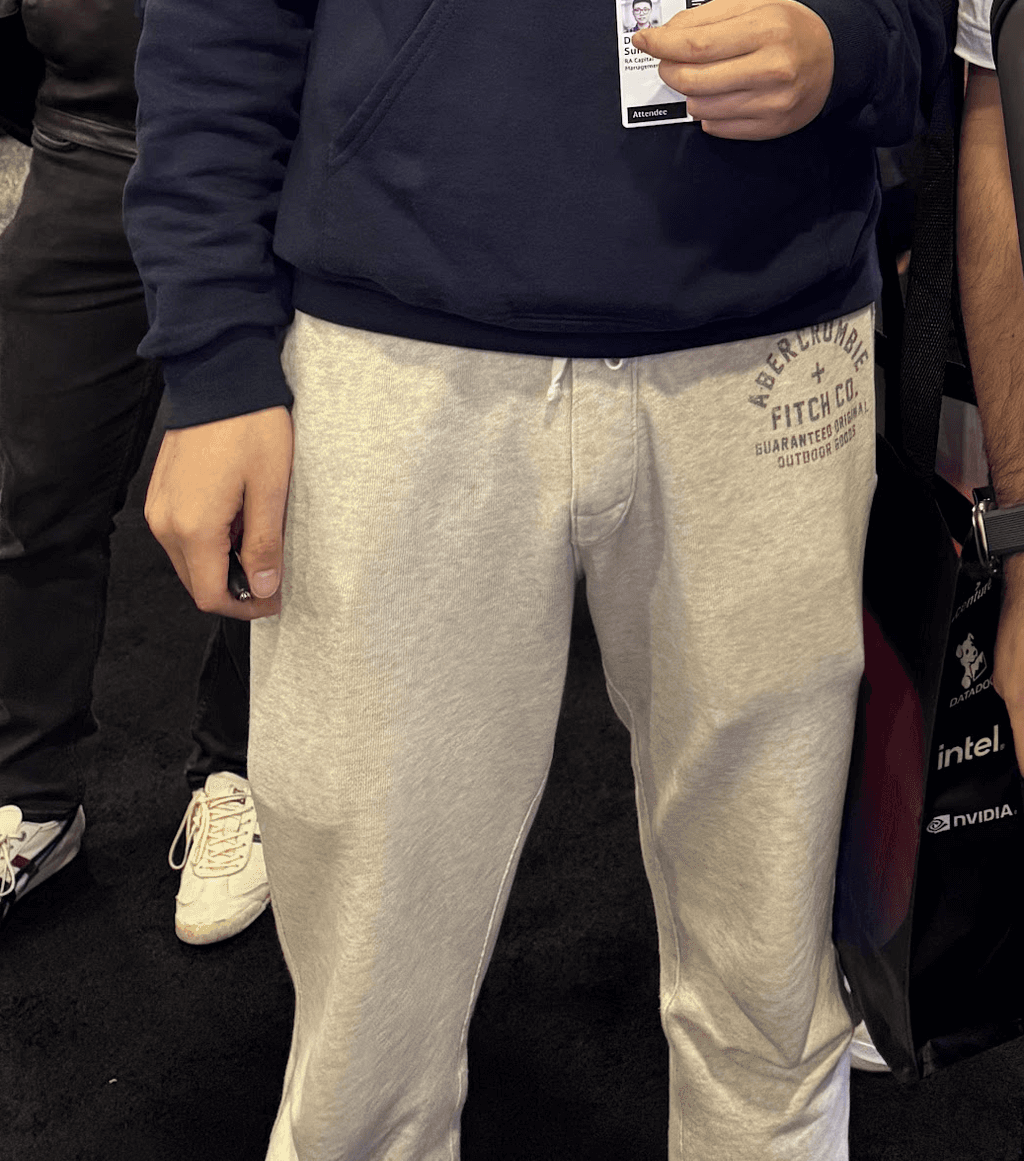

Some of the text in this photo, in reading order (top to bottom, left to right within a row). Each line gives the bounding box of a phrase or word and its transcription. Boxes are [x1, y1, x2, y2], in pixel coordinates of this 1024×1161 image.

[632, 108, 668, 119] Attendee
[747, 319, 869, 409] ABERCROMBIE
[755, 400, 869, 457] GUARANTEED ORIGINAL
[771, 376, 859, 431] FITCH CO.
[777, 424, 857, 469] OUTDOOR GOODS
